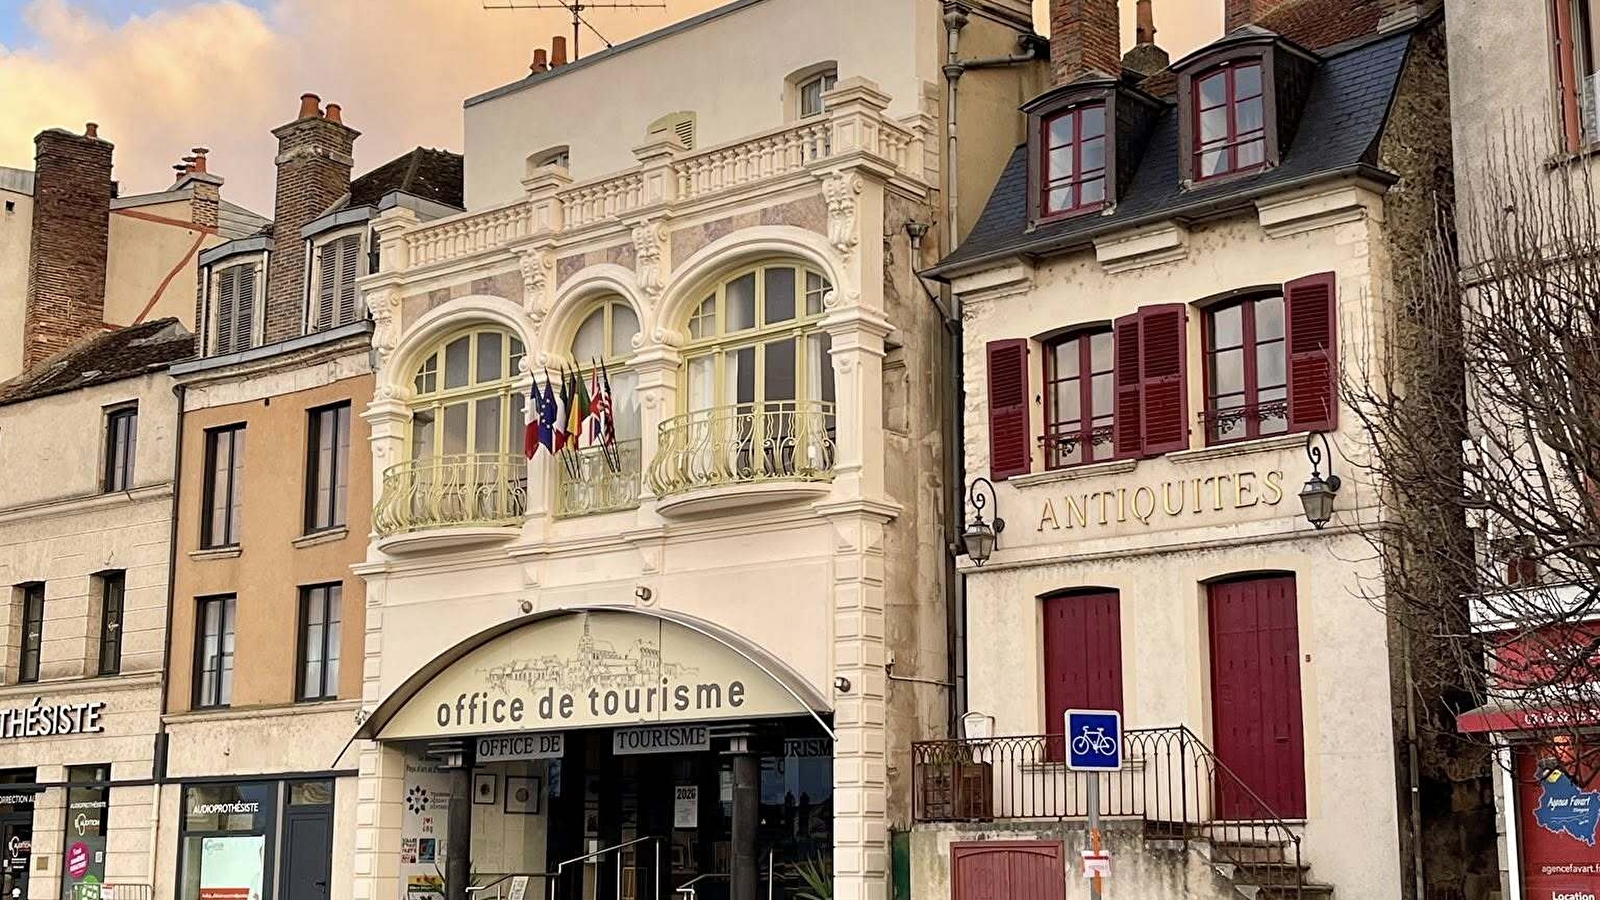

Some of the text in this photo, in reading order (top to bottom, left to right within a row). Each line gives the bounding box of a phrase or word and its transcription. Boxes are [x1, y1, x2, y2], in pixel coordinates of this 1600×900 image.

[1037, 470, 1283, 531] ANTIQUITES
[0, 697, 104, 737] THÉSISTE
[437, 678, 745, 727] office de tourisme
[479, 735, 561, 757] OFFICE DE
[617, 727, 707, 749] TOURISME
[193, 800, 259, 814] AUDIOPROTHÉSISTE
